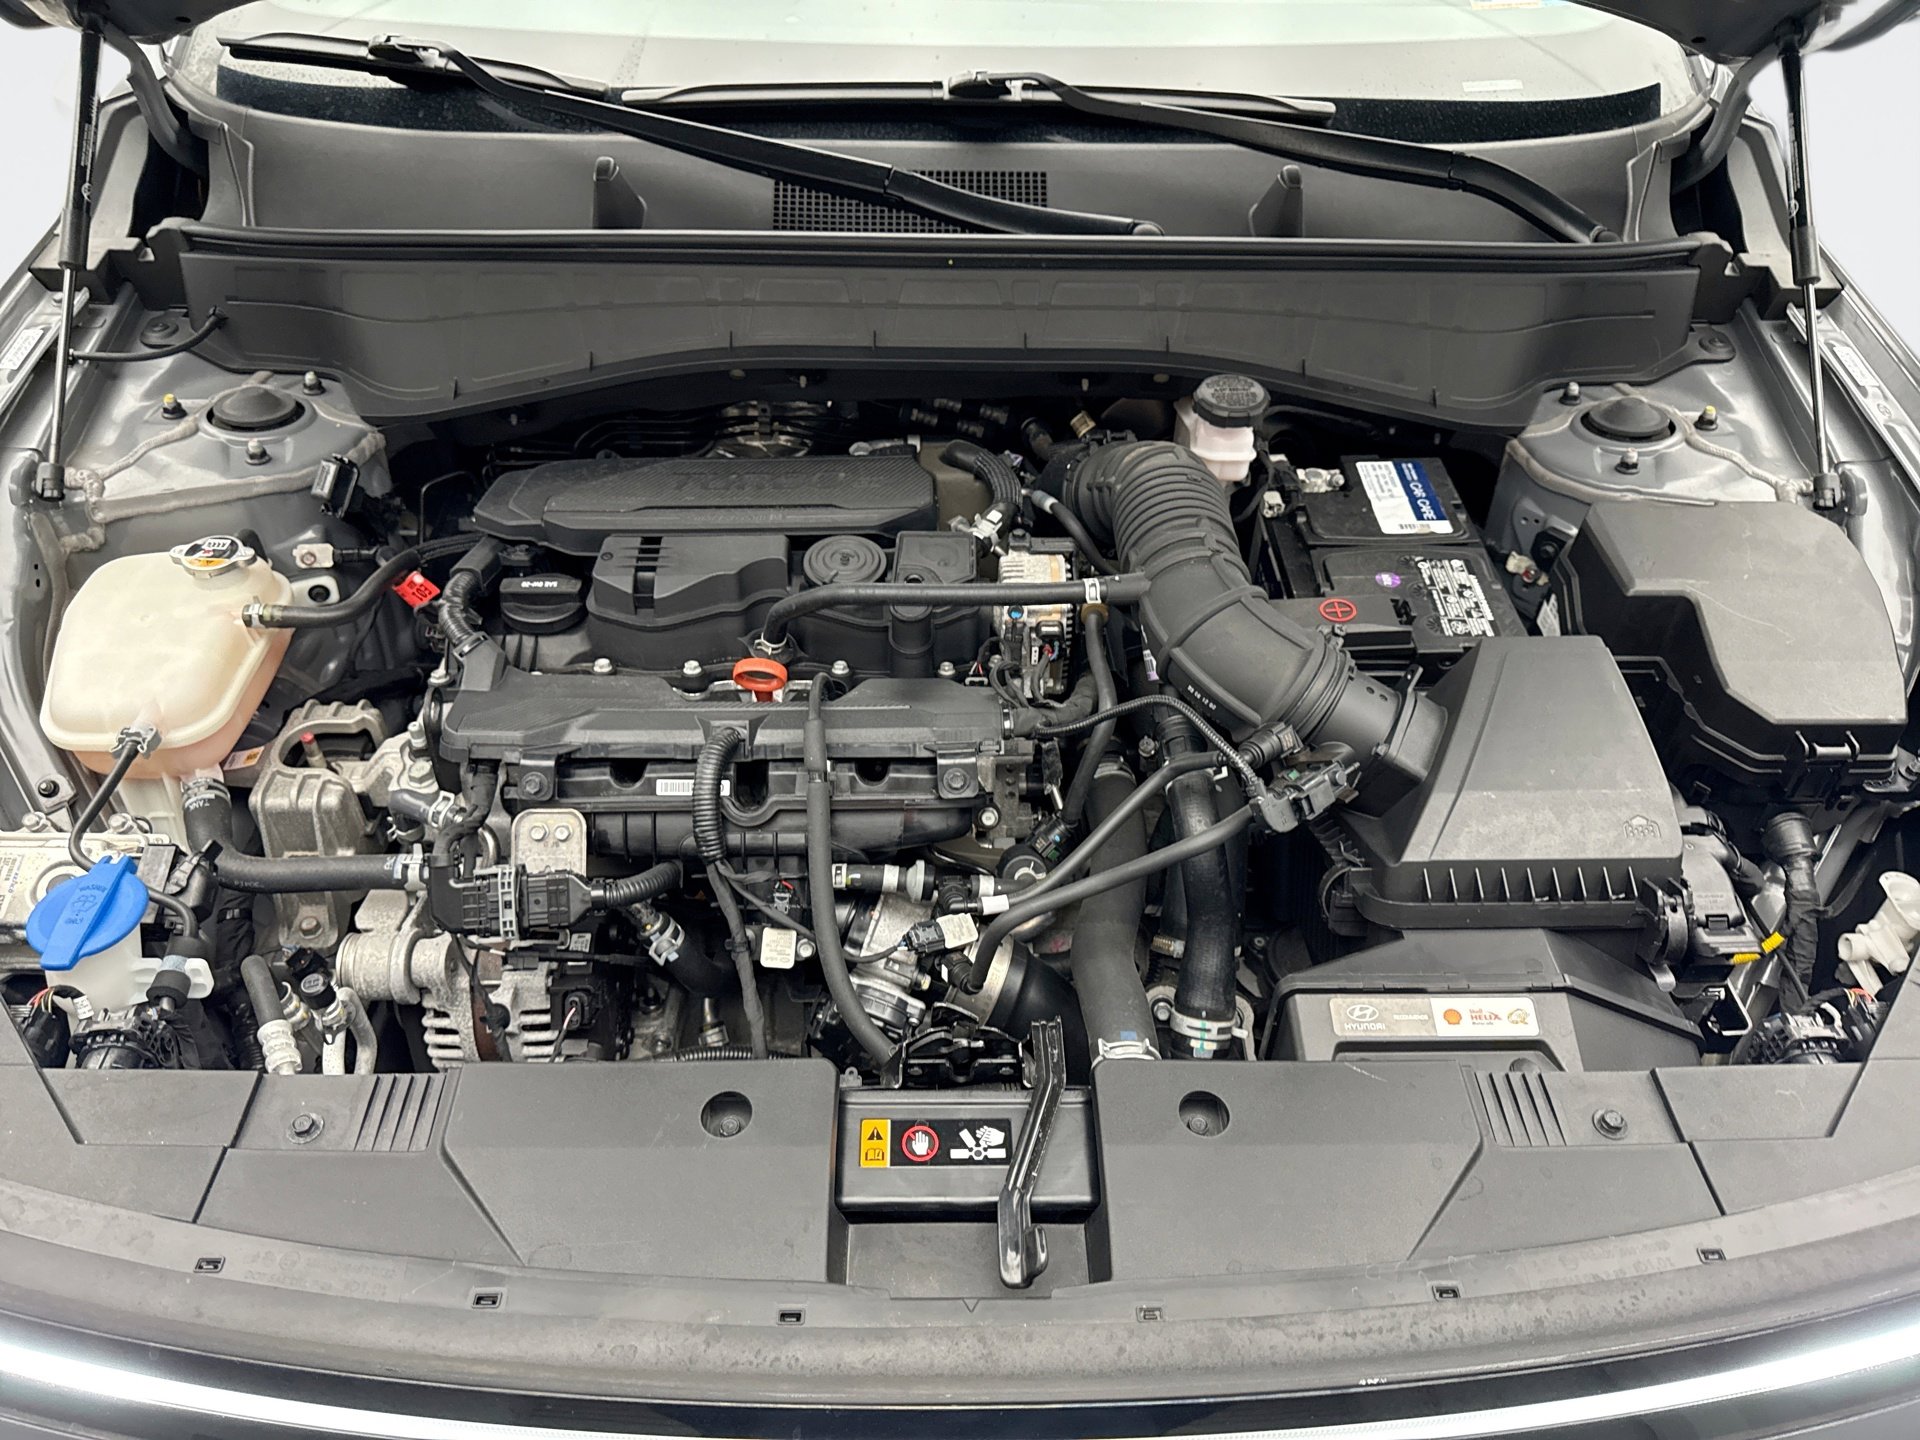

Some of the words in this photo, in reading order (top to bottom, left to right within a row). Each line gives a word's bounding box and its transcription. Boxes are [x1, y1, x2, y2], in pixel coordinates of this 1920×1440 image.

[1417, 499, 1437, 520] CARE
[1470, 1011, 1503, 1021] HELIX
[1344, 1022, 1386, 1031] HYUNDAI
